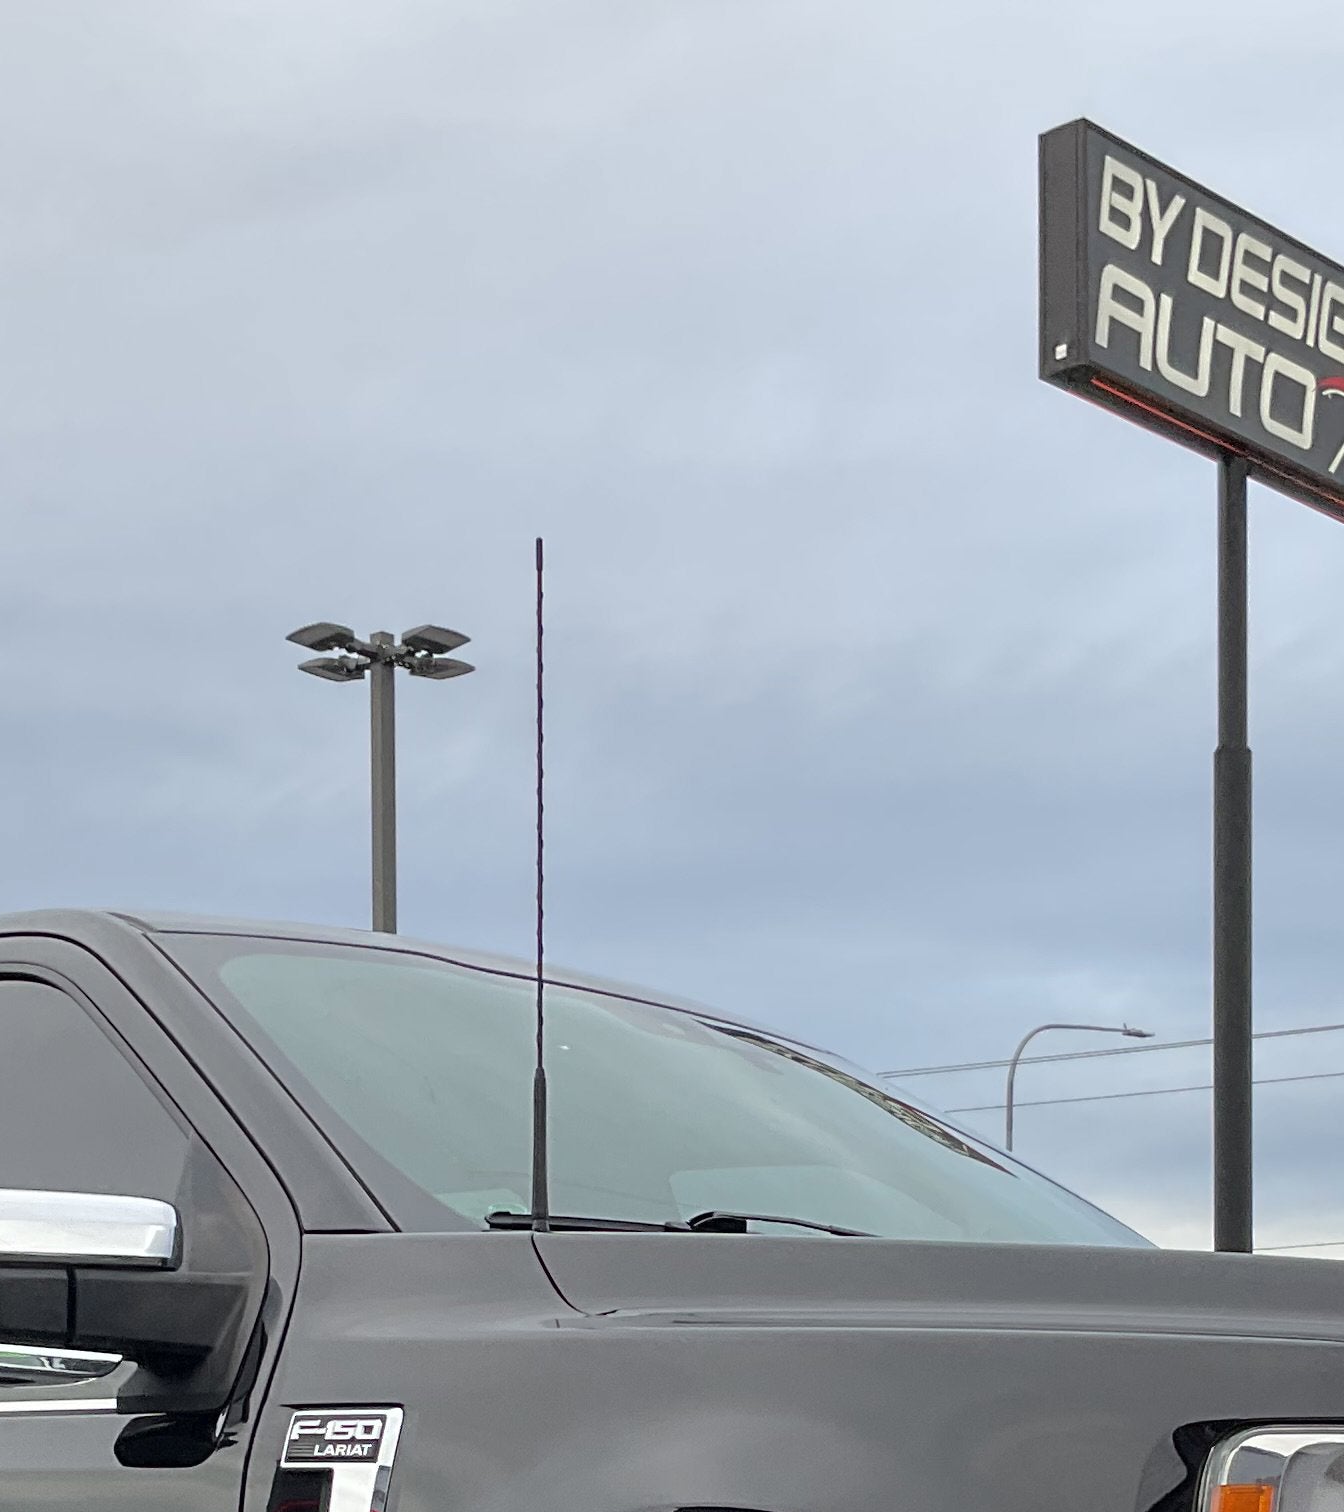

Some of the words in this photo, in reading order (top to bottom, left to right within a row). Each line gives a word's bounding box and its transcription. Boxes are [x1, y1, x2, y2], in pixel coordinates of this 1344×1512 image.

[1098, 154, 1186, 266] BY
[1094, 263, 1317, 451] AUTO
[289, 1418, 383, 1441] F-150
[313, 1443, 373, 1457] LARIAT
